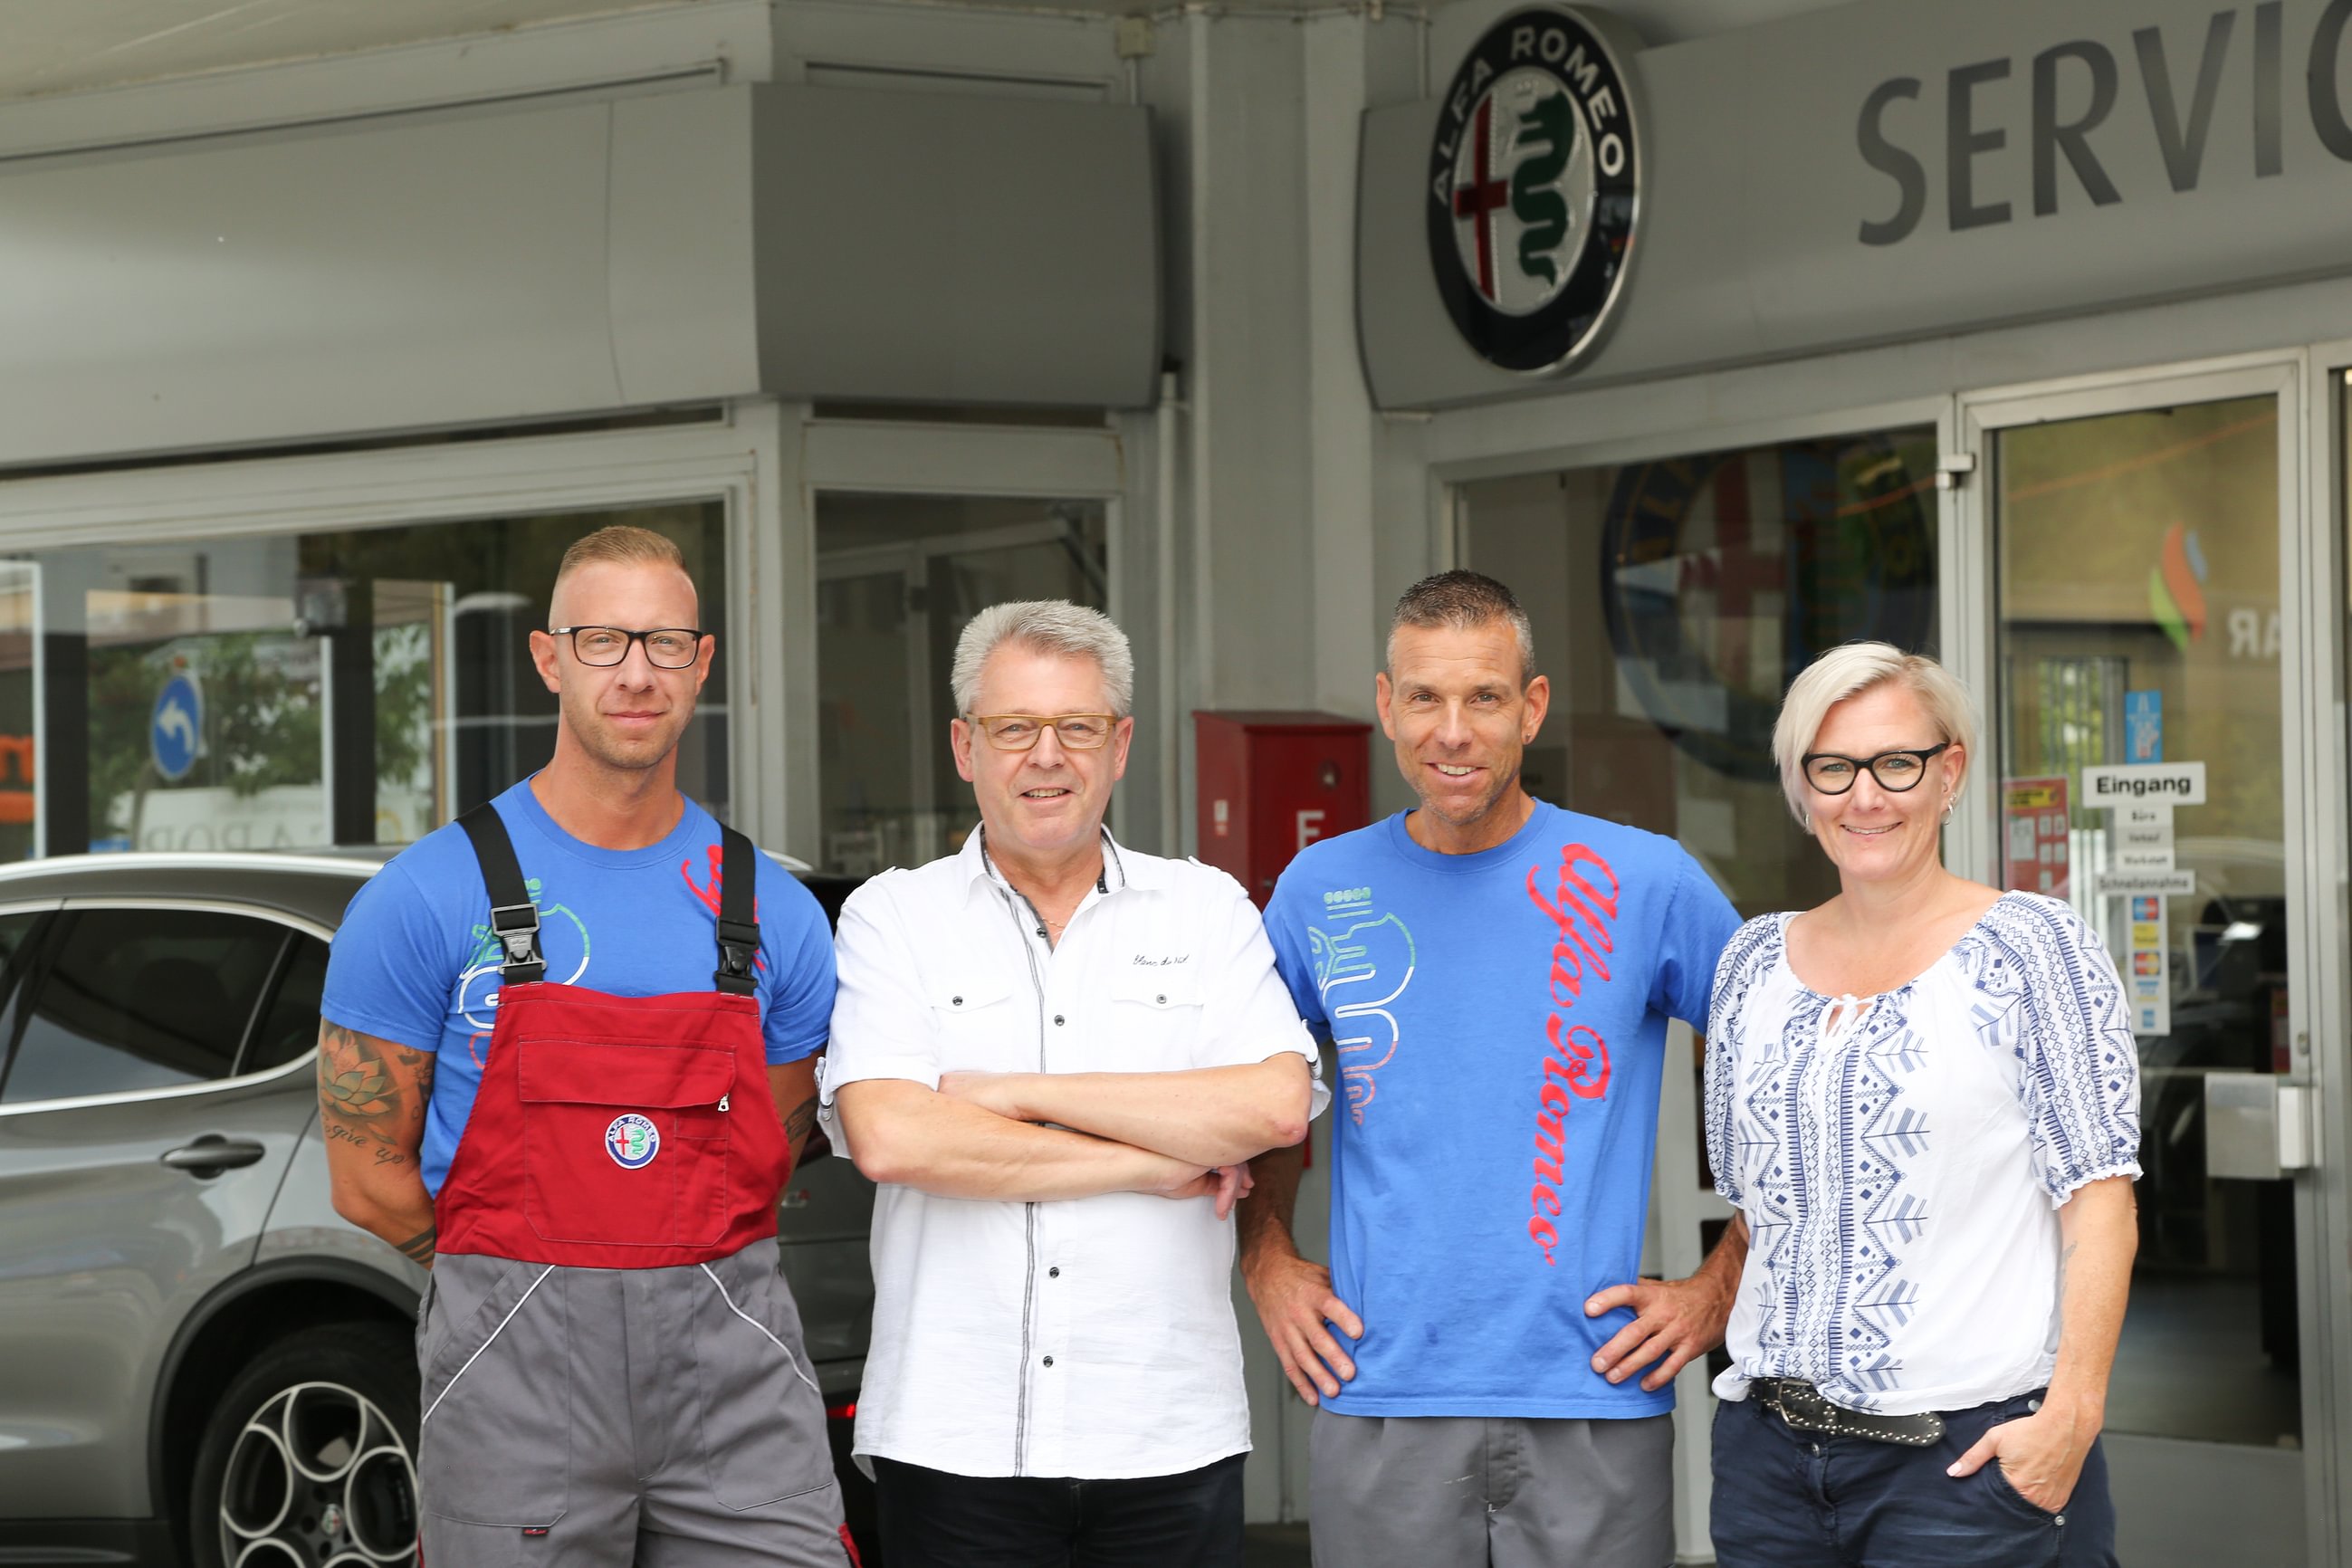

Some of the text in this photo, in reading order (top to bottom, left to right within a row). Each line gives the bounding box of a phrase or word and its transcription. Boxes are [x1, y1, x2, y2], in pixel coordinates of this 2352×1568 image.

[1434, 25, 1625, 206] ALFA ROMEO
[2096, 776, 2192, 798] Eingang
[1525, 842, 1621, 1267] Alfa Romeo
[329, 1124, 367, 1148] give
[607, 1116, 656, 1143] ALFA ROMEO
[373, 1146, 406, 1166] up
